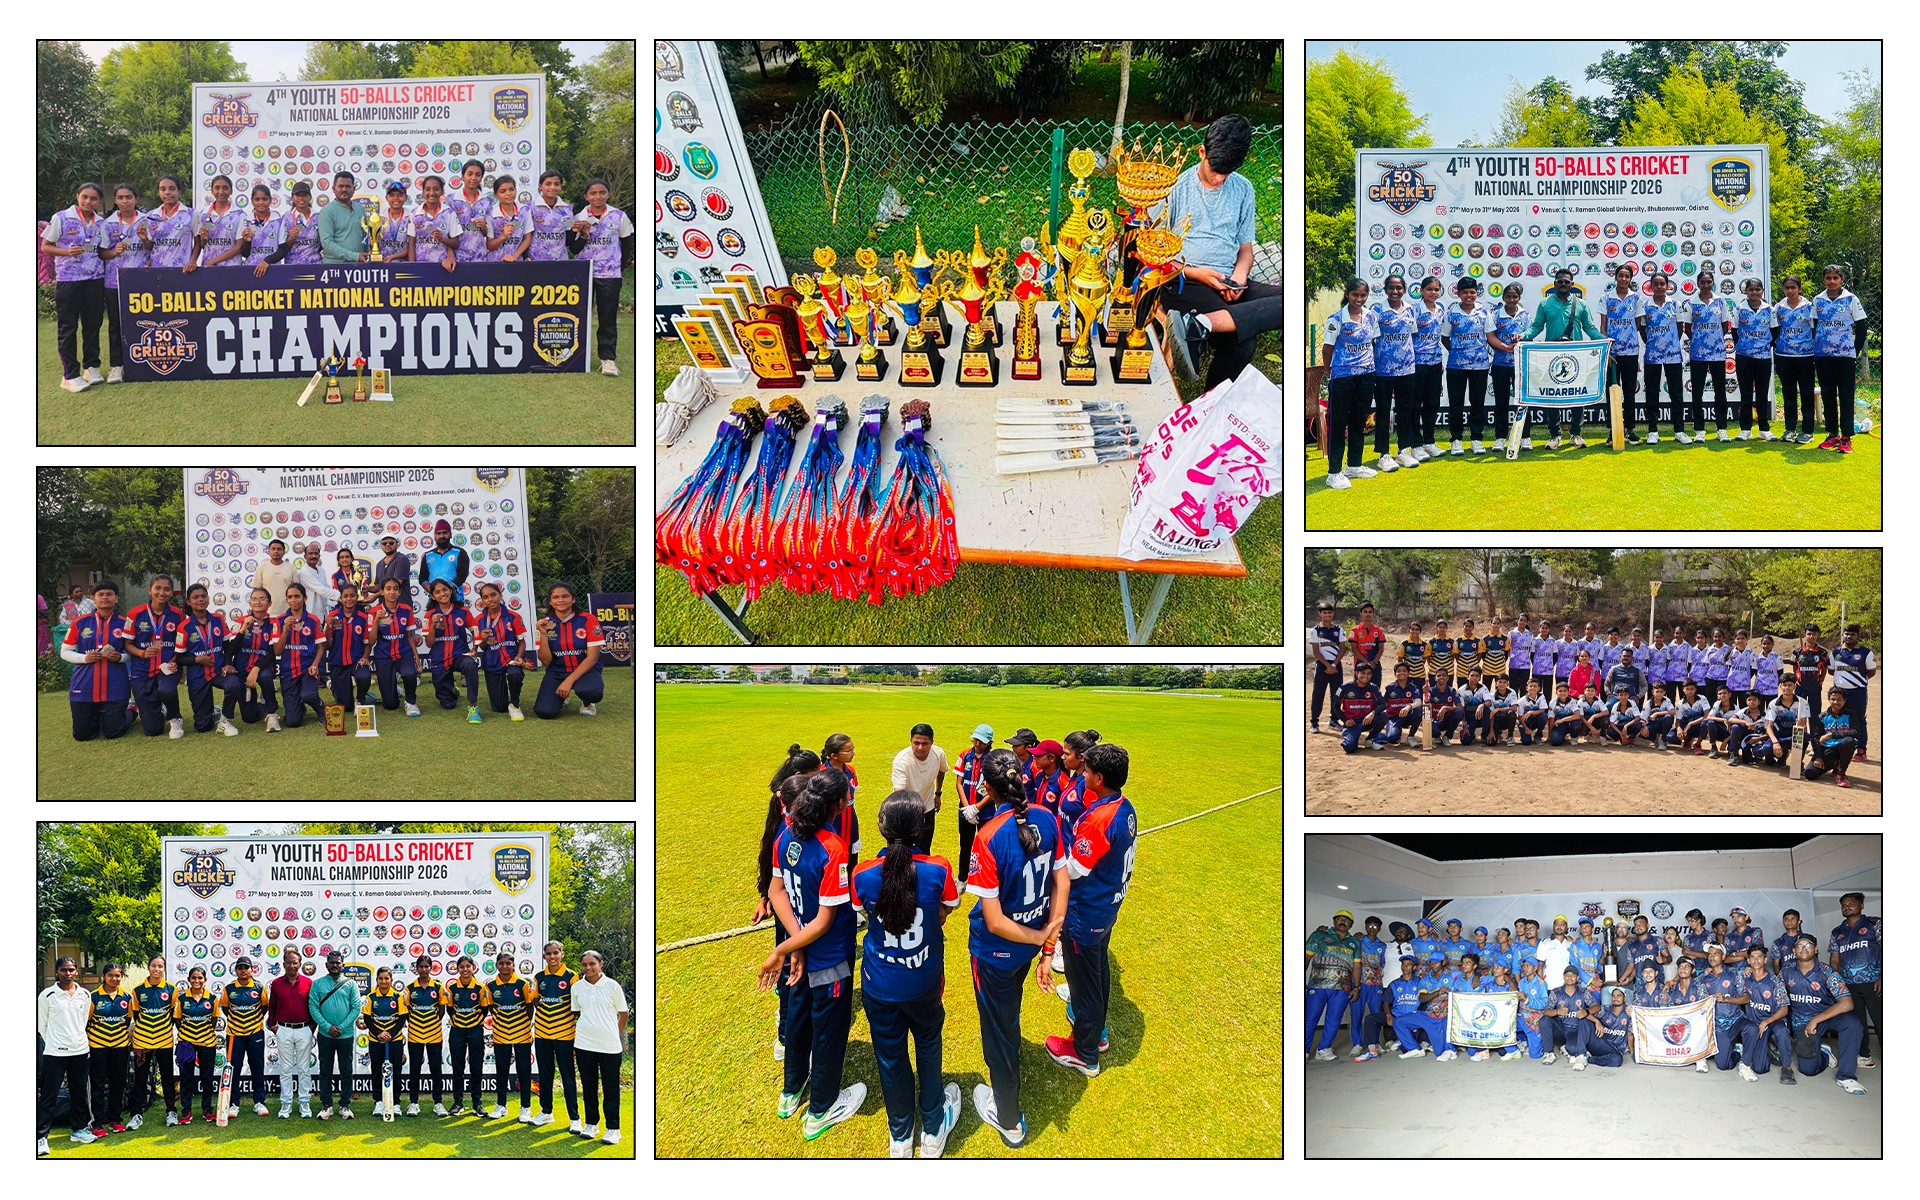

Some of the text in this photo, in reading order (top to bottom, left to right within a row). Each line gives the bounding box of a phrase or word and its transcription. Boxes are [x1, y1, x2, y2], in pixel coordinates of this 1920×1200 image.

[266, 89, 287, 106] 4TH
[291, 88, 336, 106] YOUTH
[340, 86, 410, 105] 50-BALLS
[414, 84, 475, 103] CRICKET
[223, 101, 238, 112] 50
[496, 103, 526, 111] NATIONAL
[203, 114, 258, 125] CRICKET
[289, 105, 451, 122] NATIONAL CHAMPIONSHIP 2026
[1446, 155, 1690, 177] 4TH YOUTH 50-BALLS CRICKET
[1393, 170, 1412, 183] 50
[1715, 177, 1747, 186] NATIONAL
[1369, 186, 1436, 198] CRICKET
[1474, 179, 1663, 196] NATIONAL CHAMPIONSHIP 2026
[1461, 206, 1474, 214] May
[1492, 206, 1505, 214] May
[1616, 205, 1646, 213] University,
[320, 268, 389, 284] 4TH YOUTH
[128, 284, 580, 314] 50-BALLS CRICKET NATIONAL CHAMPIONSHIP 2026
[154, 329, 172, 342] 50
[540, 331, 572, 340] NATIONAL
[205, 311, 523, 374] CHAMPIONS
[132, 344, 196, 358] CRICKET
[1538, 386, 1588, 397] VIDARBHA
[1227, 413, 1271, 453] ESTD: 1992
[214, 470, 229, 480] 50
[279, 468, 435, 489] NATIONAL CHAMPIONSHIP 2026
[195, 481, 249, 493] CRICKET
[1140, 539, 1156, 553] NEAR
[614, 631, 626, 640] 50
[244, 841, 474, 863] 4TH YOUTH 50-BALLS CRICKET
[196, 857, 213, 869] 50
[497, 863, 528, 871] NATIONAL
[173, 871, 236, 883] CRICKET
[271, 864, 448, 881] NATIONAL CHAMPIONSHIP 2026
[1022, 850, 1052, 906] 17
[403, 889, 432, 897] University,
[783, 868, 804, 916] 45
[1648, 925, 1658, 935] &
[1839, 940, 1869, 953] BIHAR
[1789, 993, 1822, 1004] BIHAR
[1665, 1047, 1691, 1056] BIHAR
